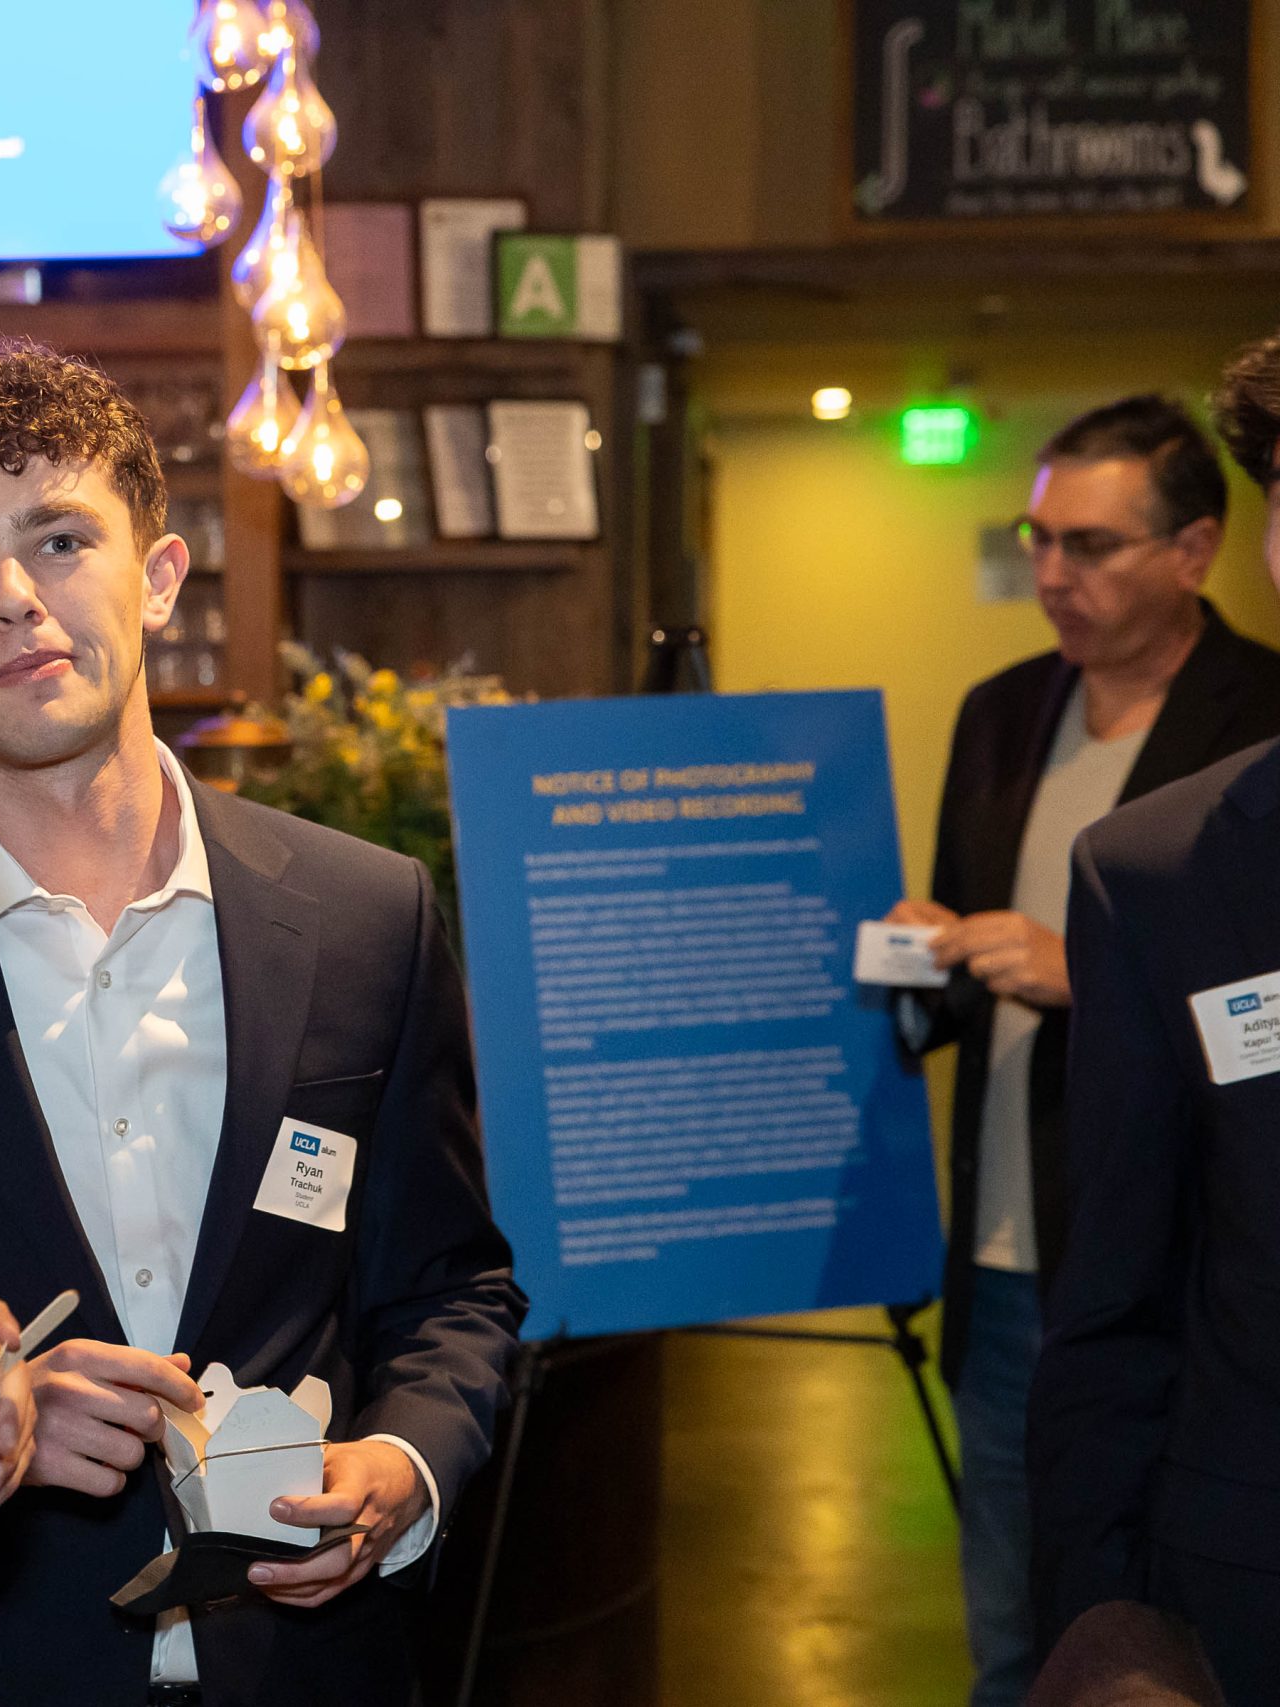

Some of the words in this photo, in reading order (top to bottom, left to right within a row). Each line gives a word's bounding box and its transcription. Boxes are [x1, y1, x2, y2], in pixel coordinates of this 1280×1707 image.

[510, 253, 566, 318] A
[532, 770, 614, 796] NOTICE
[620, 768, 649, 791] OF
[654, 762, 815, 788] PHOTOGRAPHY
[552, 802, 604, 825] AND
[607, 798, 676, 823] VIDEO
[680, 791, 805, 819] RECORDING
[1232, 999, 1257, 1012] UCLA
[295, 1137, 316, 1151] UCLA
[321, 1146, 337, 1157] alum
[296, 1161, 323, 1178] Ryan
[290, 1177, 323, 1194] Trachuk
[295, 1201, 310, 1209] UCLA
